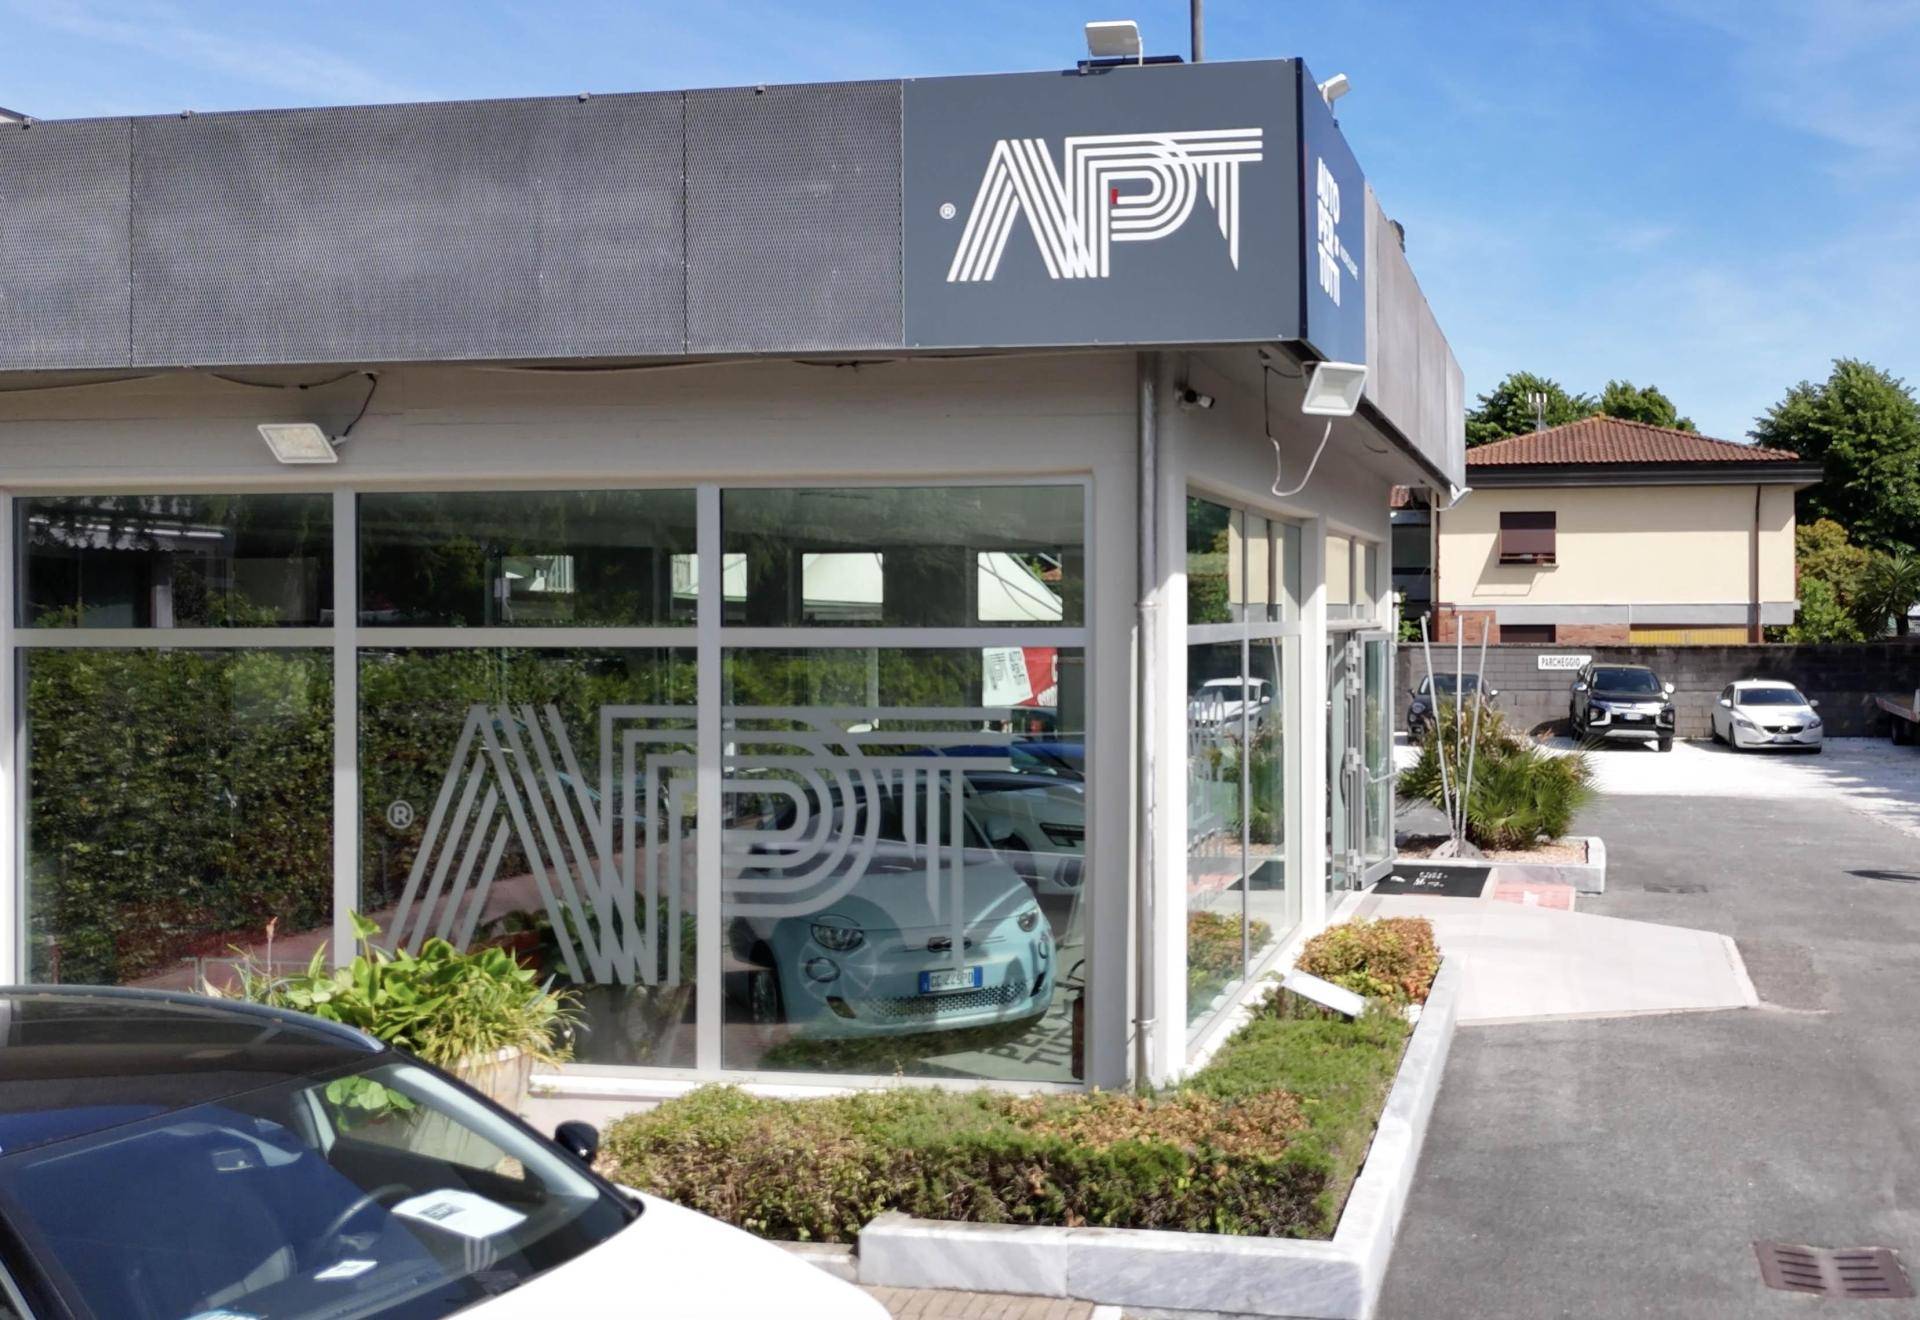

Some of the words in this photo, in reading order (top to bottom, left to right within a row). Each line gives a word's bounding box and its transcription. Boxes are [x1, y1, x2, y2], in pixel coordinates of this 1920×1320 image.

[945, 127, 1263, 282] APT
[1317, 157, 1340, 224] AUTO
[1318, 198, 1334, 258] PER
[1318, 242, 1340, 307] TUTTI
[1541, 657, 1581, 668] PARCHEGGIO
